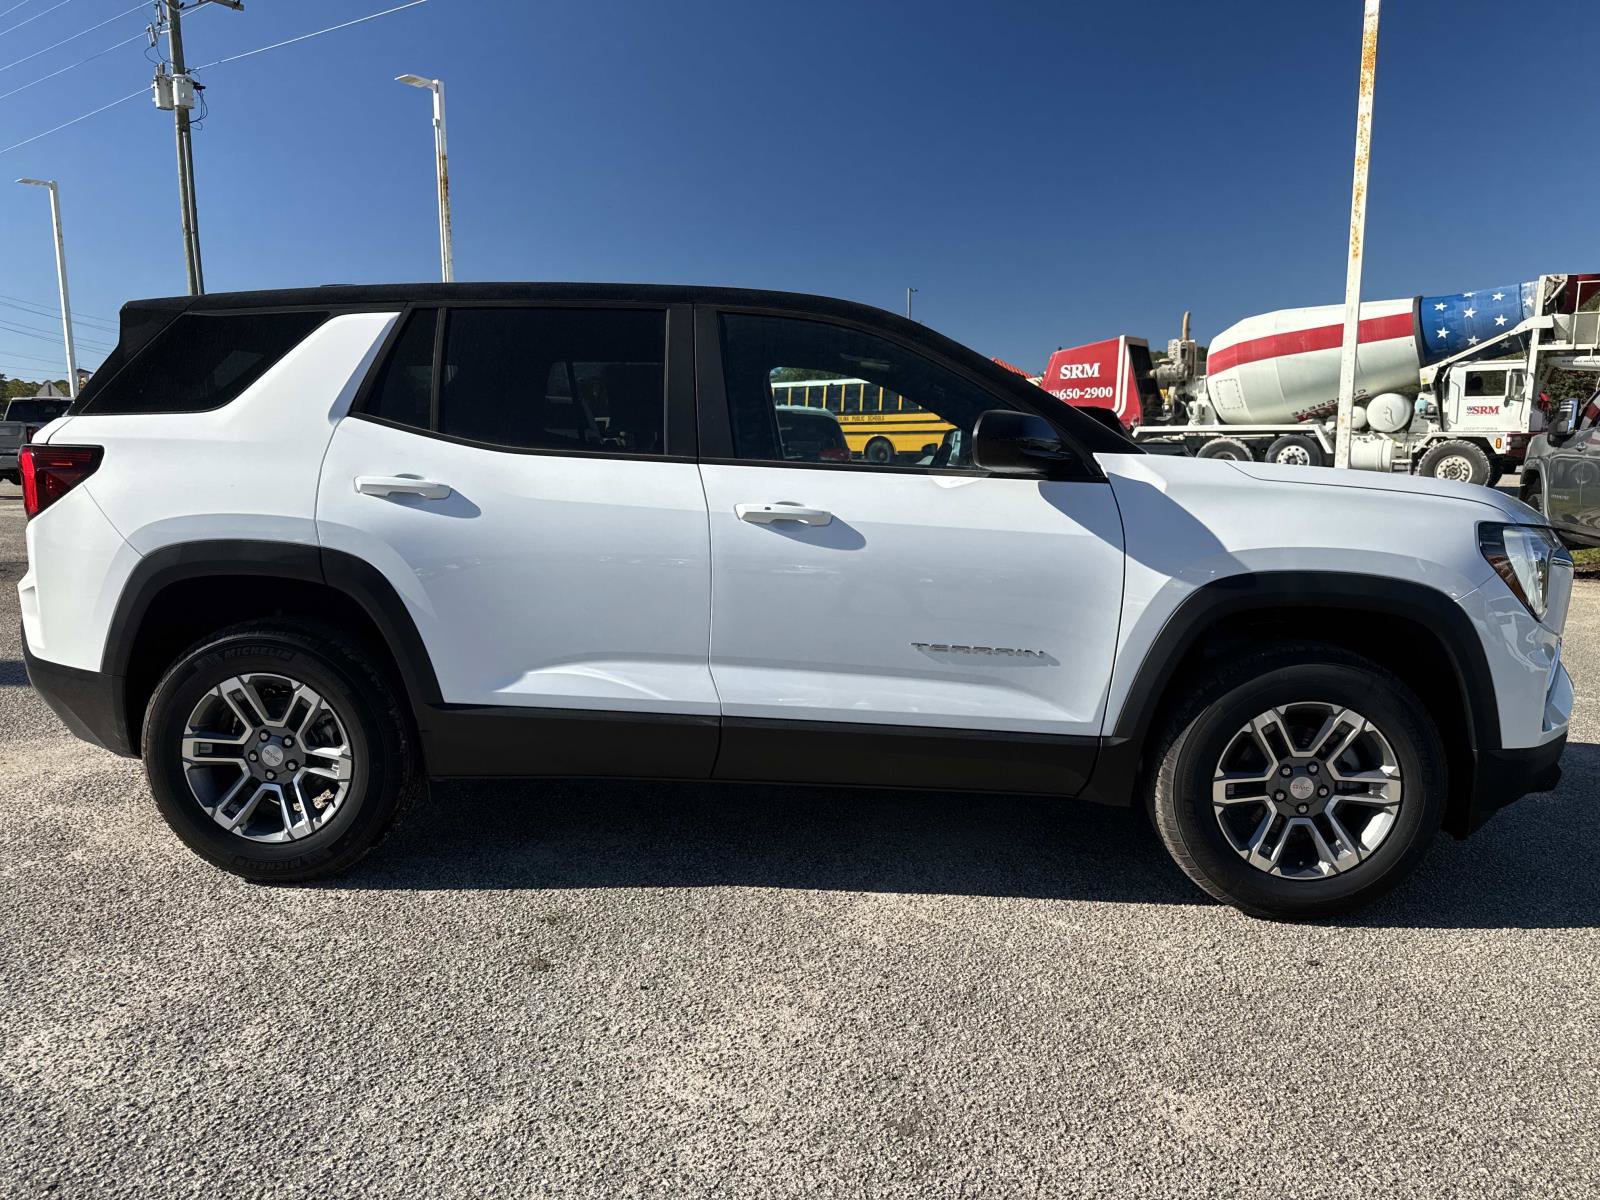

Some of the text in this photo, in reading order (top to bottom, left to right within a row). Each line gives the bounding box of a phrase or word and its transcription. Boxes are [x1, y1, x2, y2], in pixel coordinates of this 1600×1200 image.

[1060, 363, 1101, 380] SRM
[1472, 405, 1500, 415] SRM
[224, 646, 294, 661] MICHELIN
[910, 642, 1045, 657] TERRAIN
